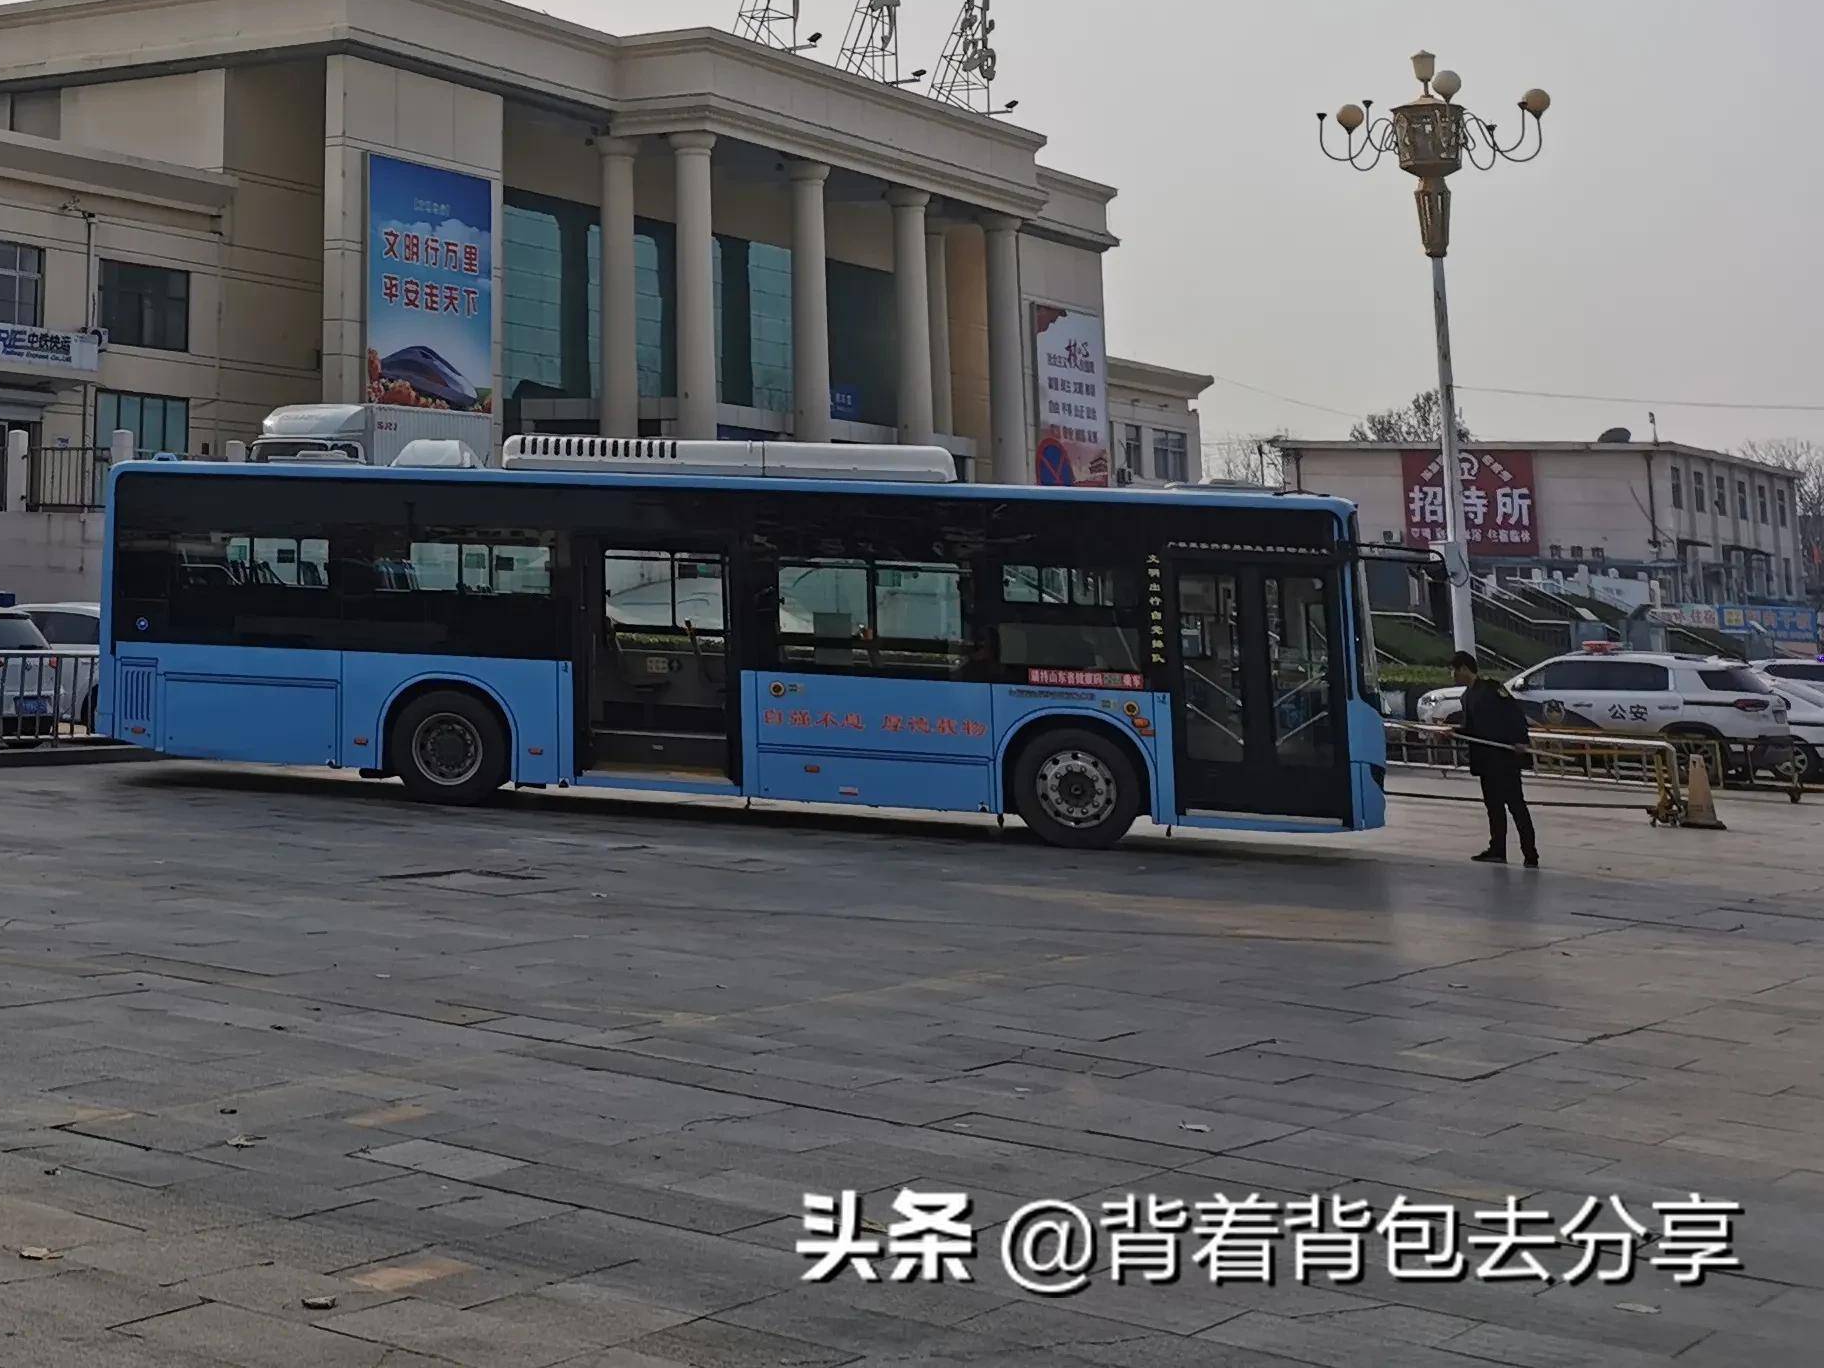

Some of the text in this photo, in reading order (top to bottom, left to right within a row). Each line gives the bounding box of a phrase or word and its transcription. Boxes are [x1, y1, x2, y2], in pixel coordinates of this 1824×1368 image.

[382, 228, 480, 275] 文明行万里
[382, 273, 480, 318] 平安走天下
[1408, 485, 1532, 526] 招待所
[1608, 703, 1648, 722] 公安
